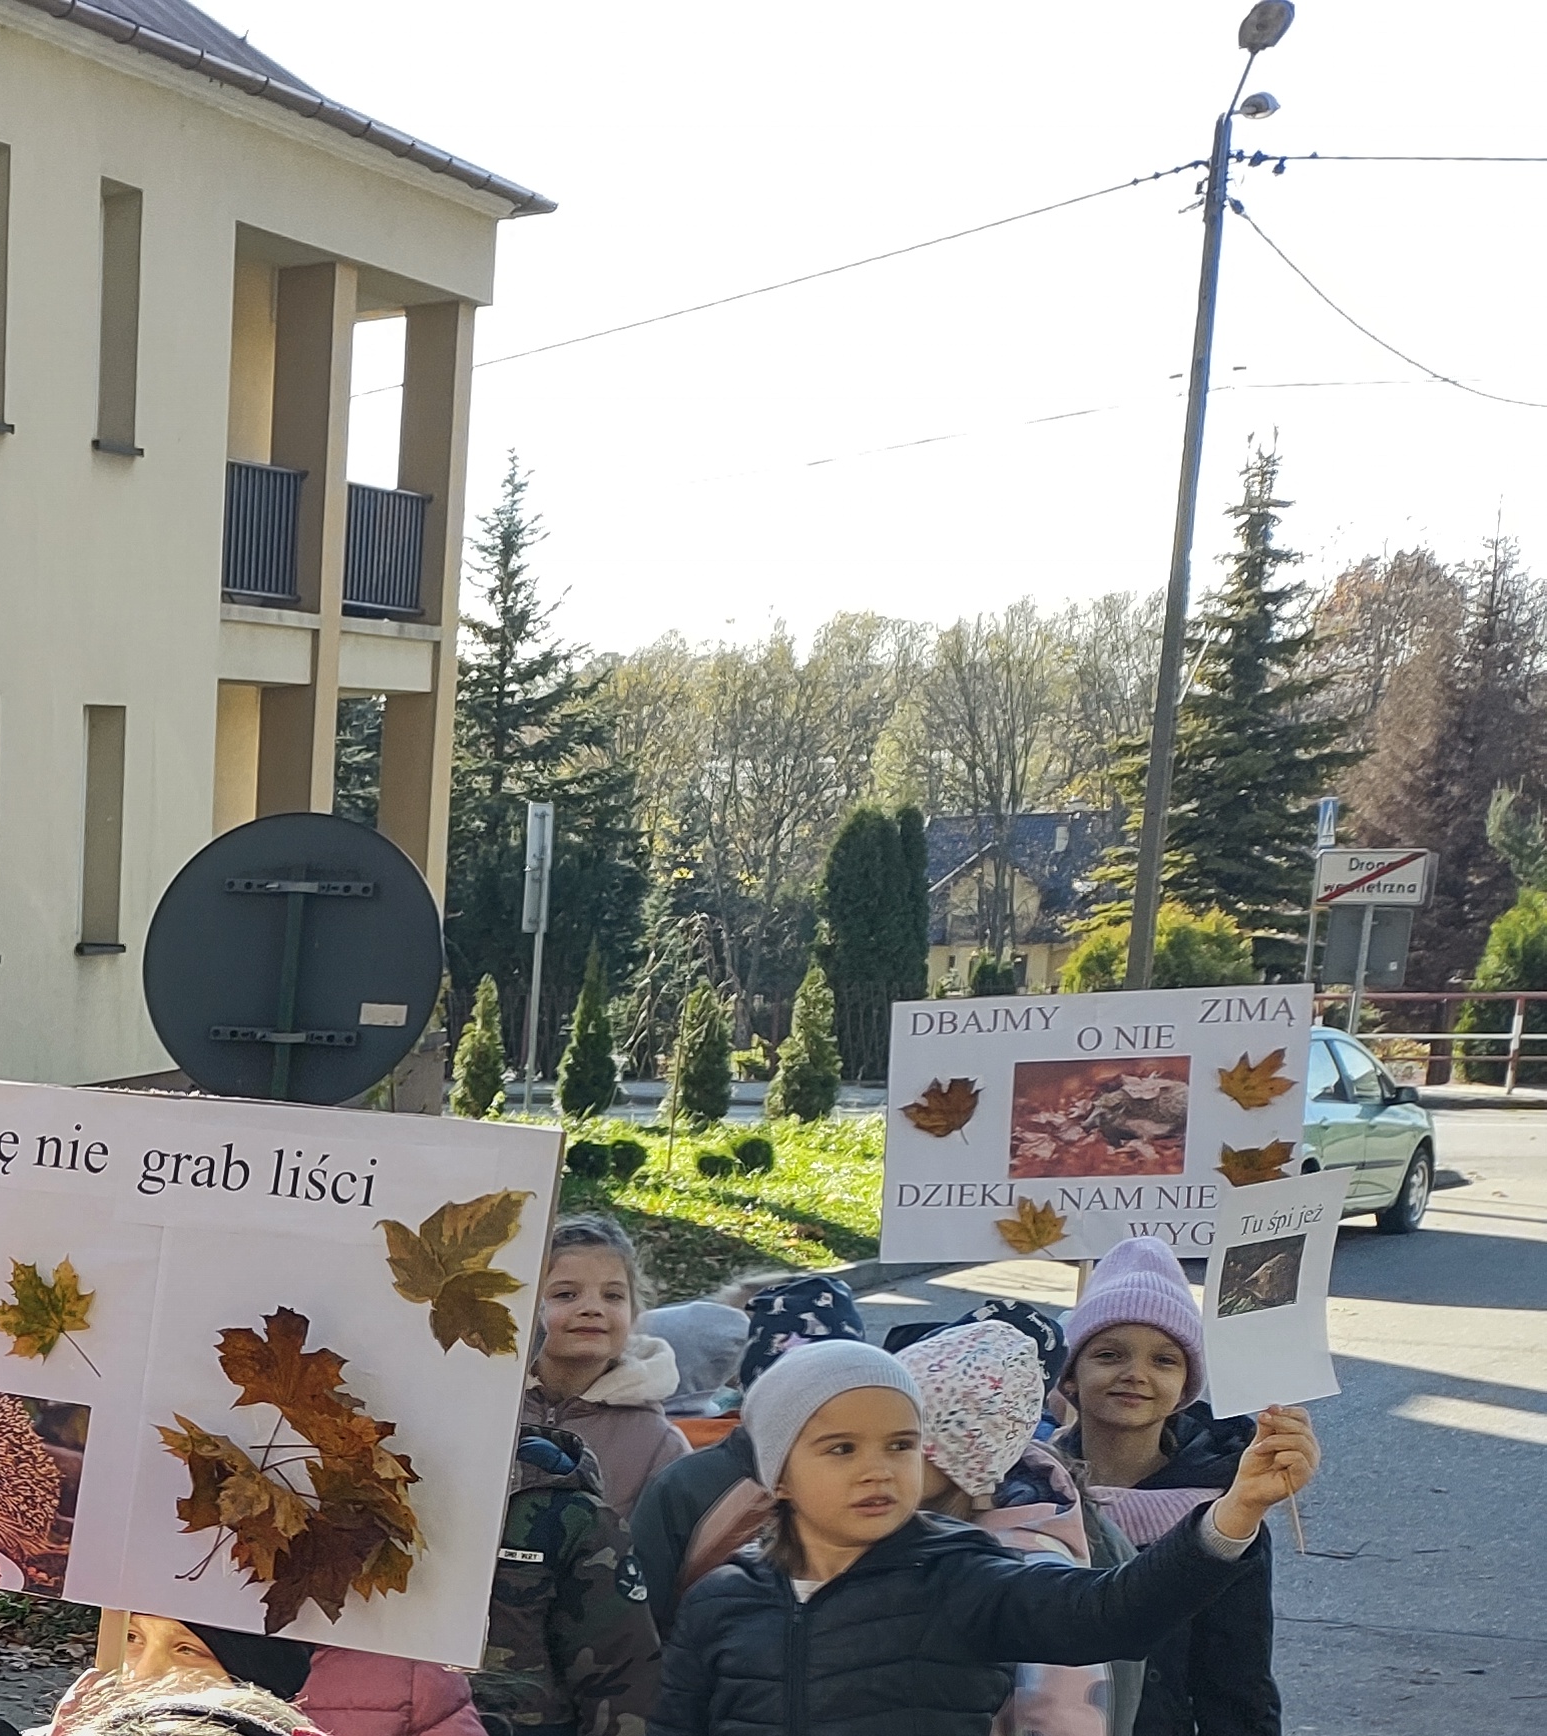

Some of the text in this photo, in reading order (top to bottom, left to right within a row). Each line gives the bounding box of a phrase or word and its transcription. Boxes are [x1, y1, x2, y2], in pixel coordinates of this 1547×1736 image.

[910, 1006, 1060, 1036] DBAJMY
[1198, 996, 1296, 1027] ZIMĄ
[1076, 1024, 1176, 1051] O NIE
[33, 1123, 110, 1174] nie
[136, 1142, 251, 1195] grab
[267, 1147, 378, 1207] liści
[897, 1183, 1218, 1212] DZIEKI NAM NIE
[1129, 1220, 1217, 1246] WYG
[1240, 1215, 1263, 1236] Tu
[1267, 1207, 1294, 1235] śpi
